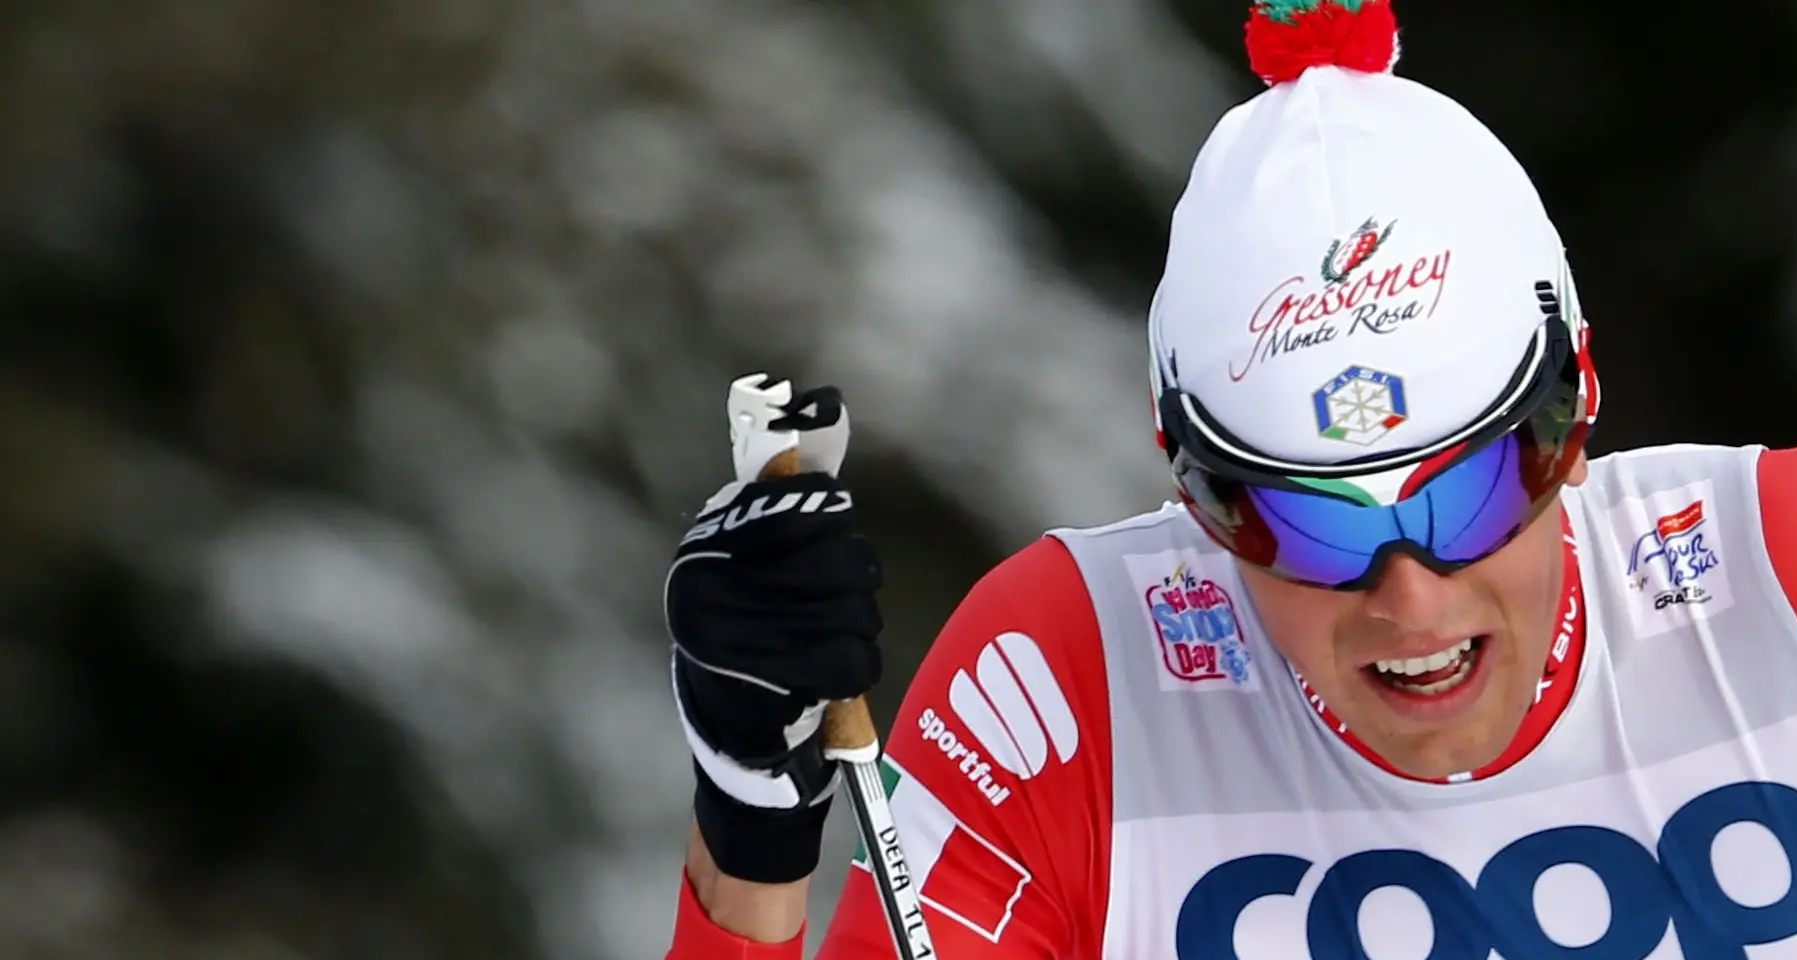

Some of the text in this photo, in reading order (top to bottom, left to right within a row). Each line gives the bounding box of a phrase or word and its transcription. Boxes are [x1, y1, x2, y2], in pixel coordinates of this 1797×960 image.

[1229, 249, 1451, 382] Gressoney
[1261, 300, 1424, 364] Monte Rosa
[1174, 643, 1216, 674] Day
[918, 707, 1012, 807] sportful
[879, 825, 912, 893] DEFA
[904, 902, 925, 939] TL
